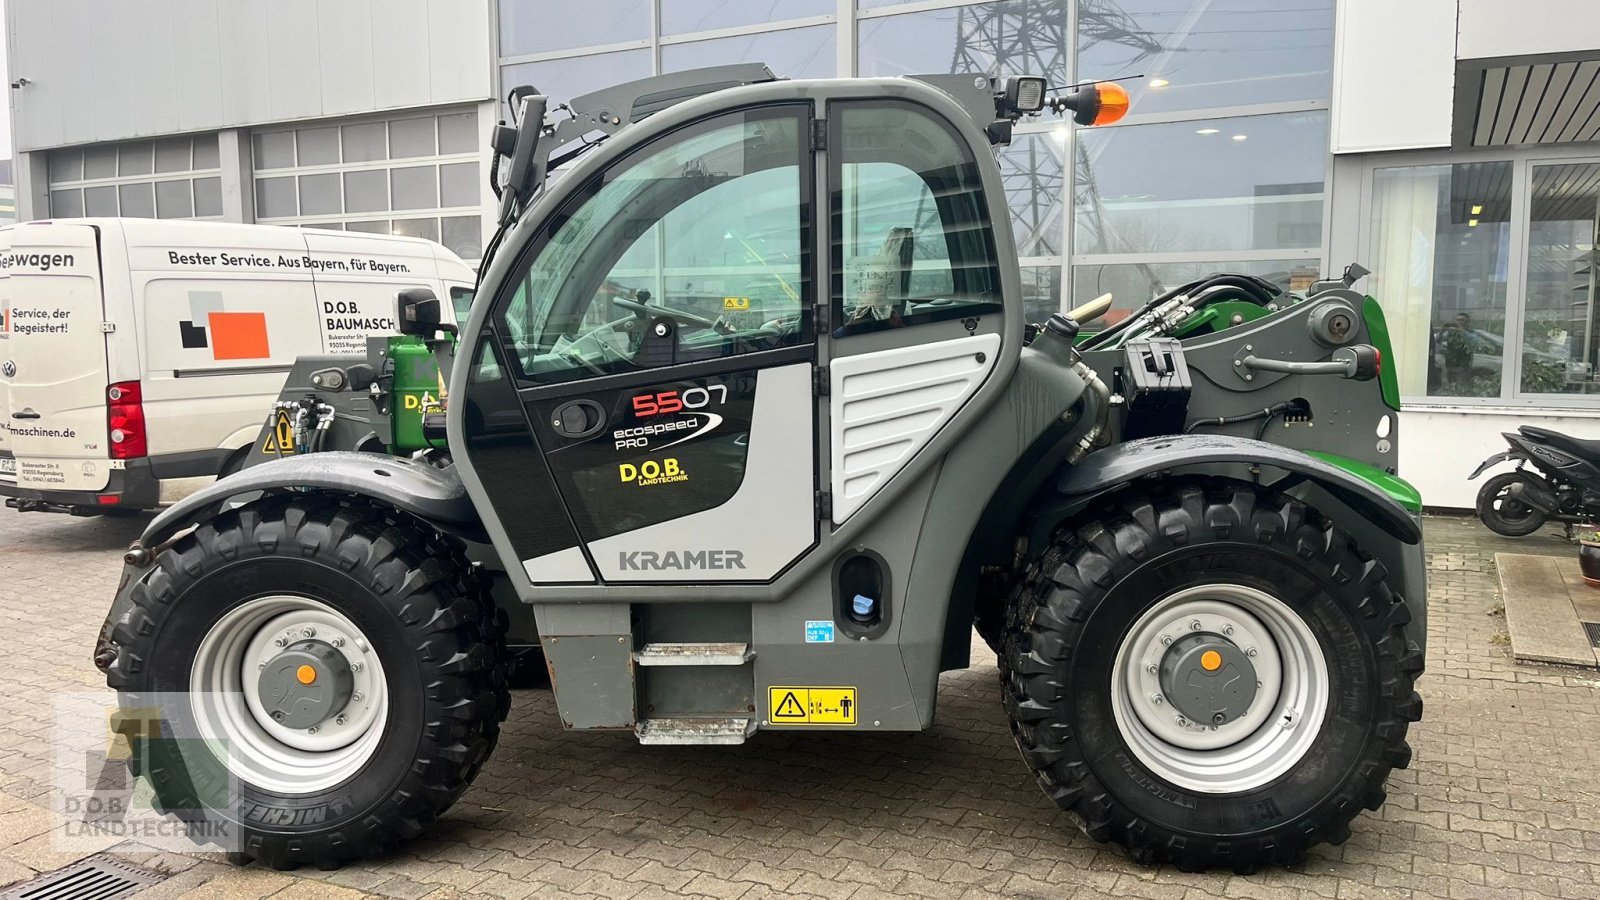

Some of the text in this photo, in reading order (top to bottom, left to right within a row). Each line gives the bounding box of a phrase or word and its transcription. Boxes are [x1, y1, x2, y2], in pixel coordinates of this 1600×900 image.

[168, 251, 410, 274] Bester Service. Aus Bayern, für Bayern.
[12, 308, 71, 320] Service, der
[324, 301, 361, 314] D.O.B.
[14, 322, 68, 335] begeistert!
[632, 384, 728, 418] 5507
[613, 418, 698, 439] ecospeed
[615, 437, 648, 451] PRO
[619, 457, 686, 482] D.O.B.
[638, 474, 689, 486] LANDTECHNIK
[619, 550, 746, 570] KRAMER
